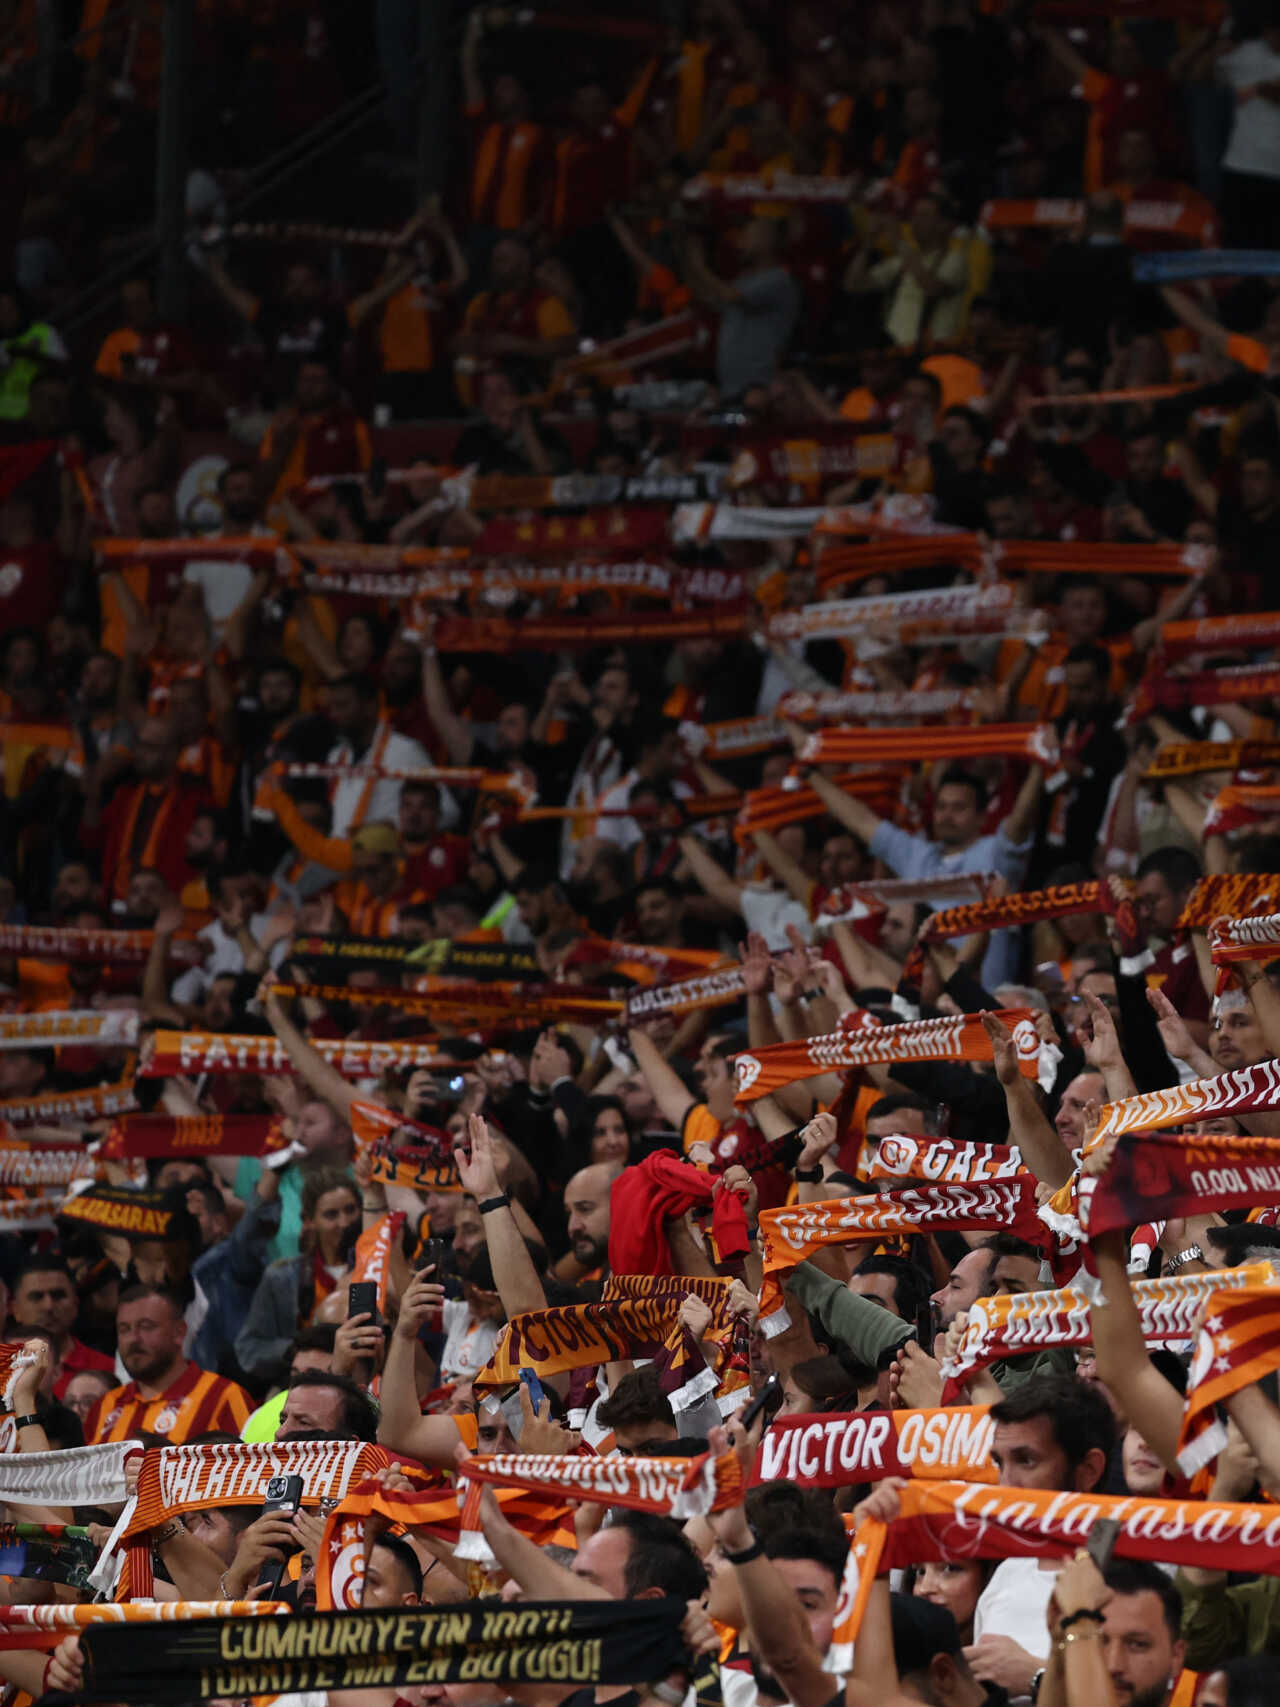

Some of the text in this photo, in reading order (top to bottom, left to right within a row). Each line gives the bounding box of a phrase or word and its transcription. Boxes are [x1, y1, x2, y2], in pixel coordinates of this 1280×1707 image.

[773, 1182, 1019, 1249] GALATASARAY
[759, 1414, 891, 1481] VICTOR
[219, 1611, 473, 1662] CUMHURİYETİN
